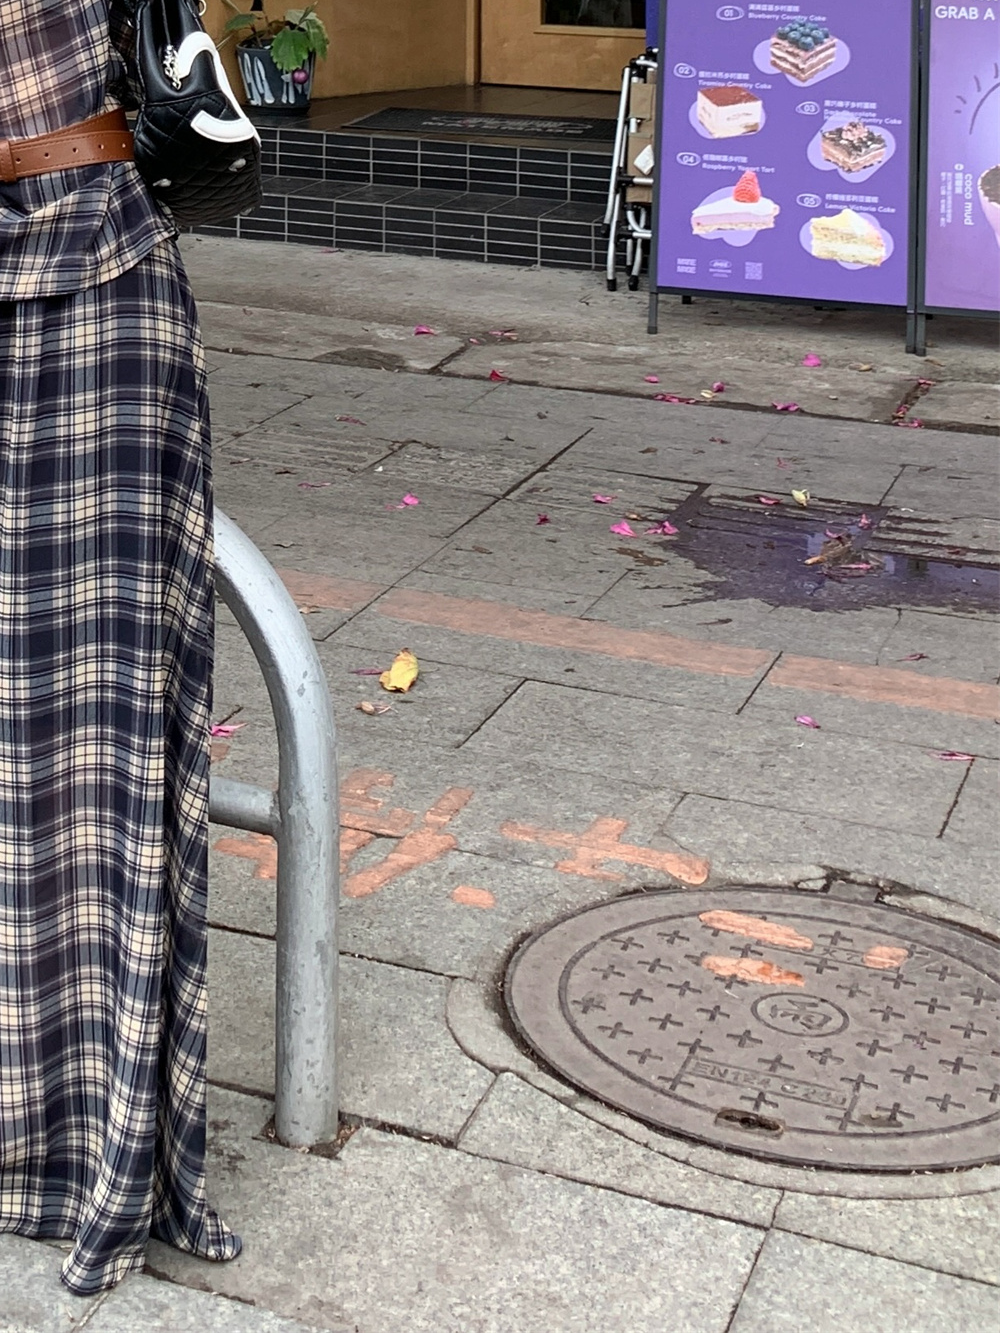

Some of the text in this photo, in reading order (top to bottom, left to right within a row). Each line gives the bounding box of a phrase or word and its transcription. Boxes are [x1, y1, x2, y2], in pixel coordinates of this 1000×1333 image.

[935, 5, 995, 21] GRAB A
[964, 173, 974, 225] coco mud
